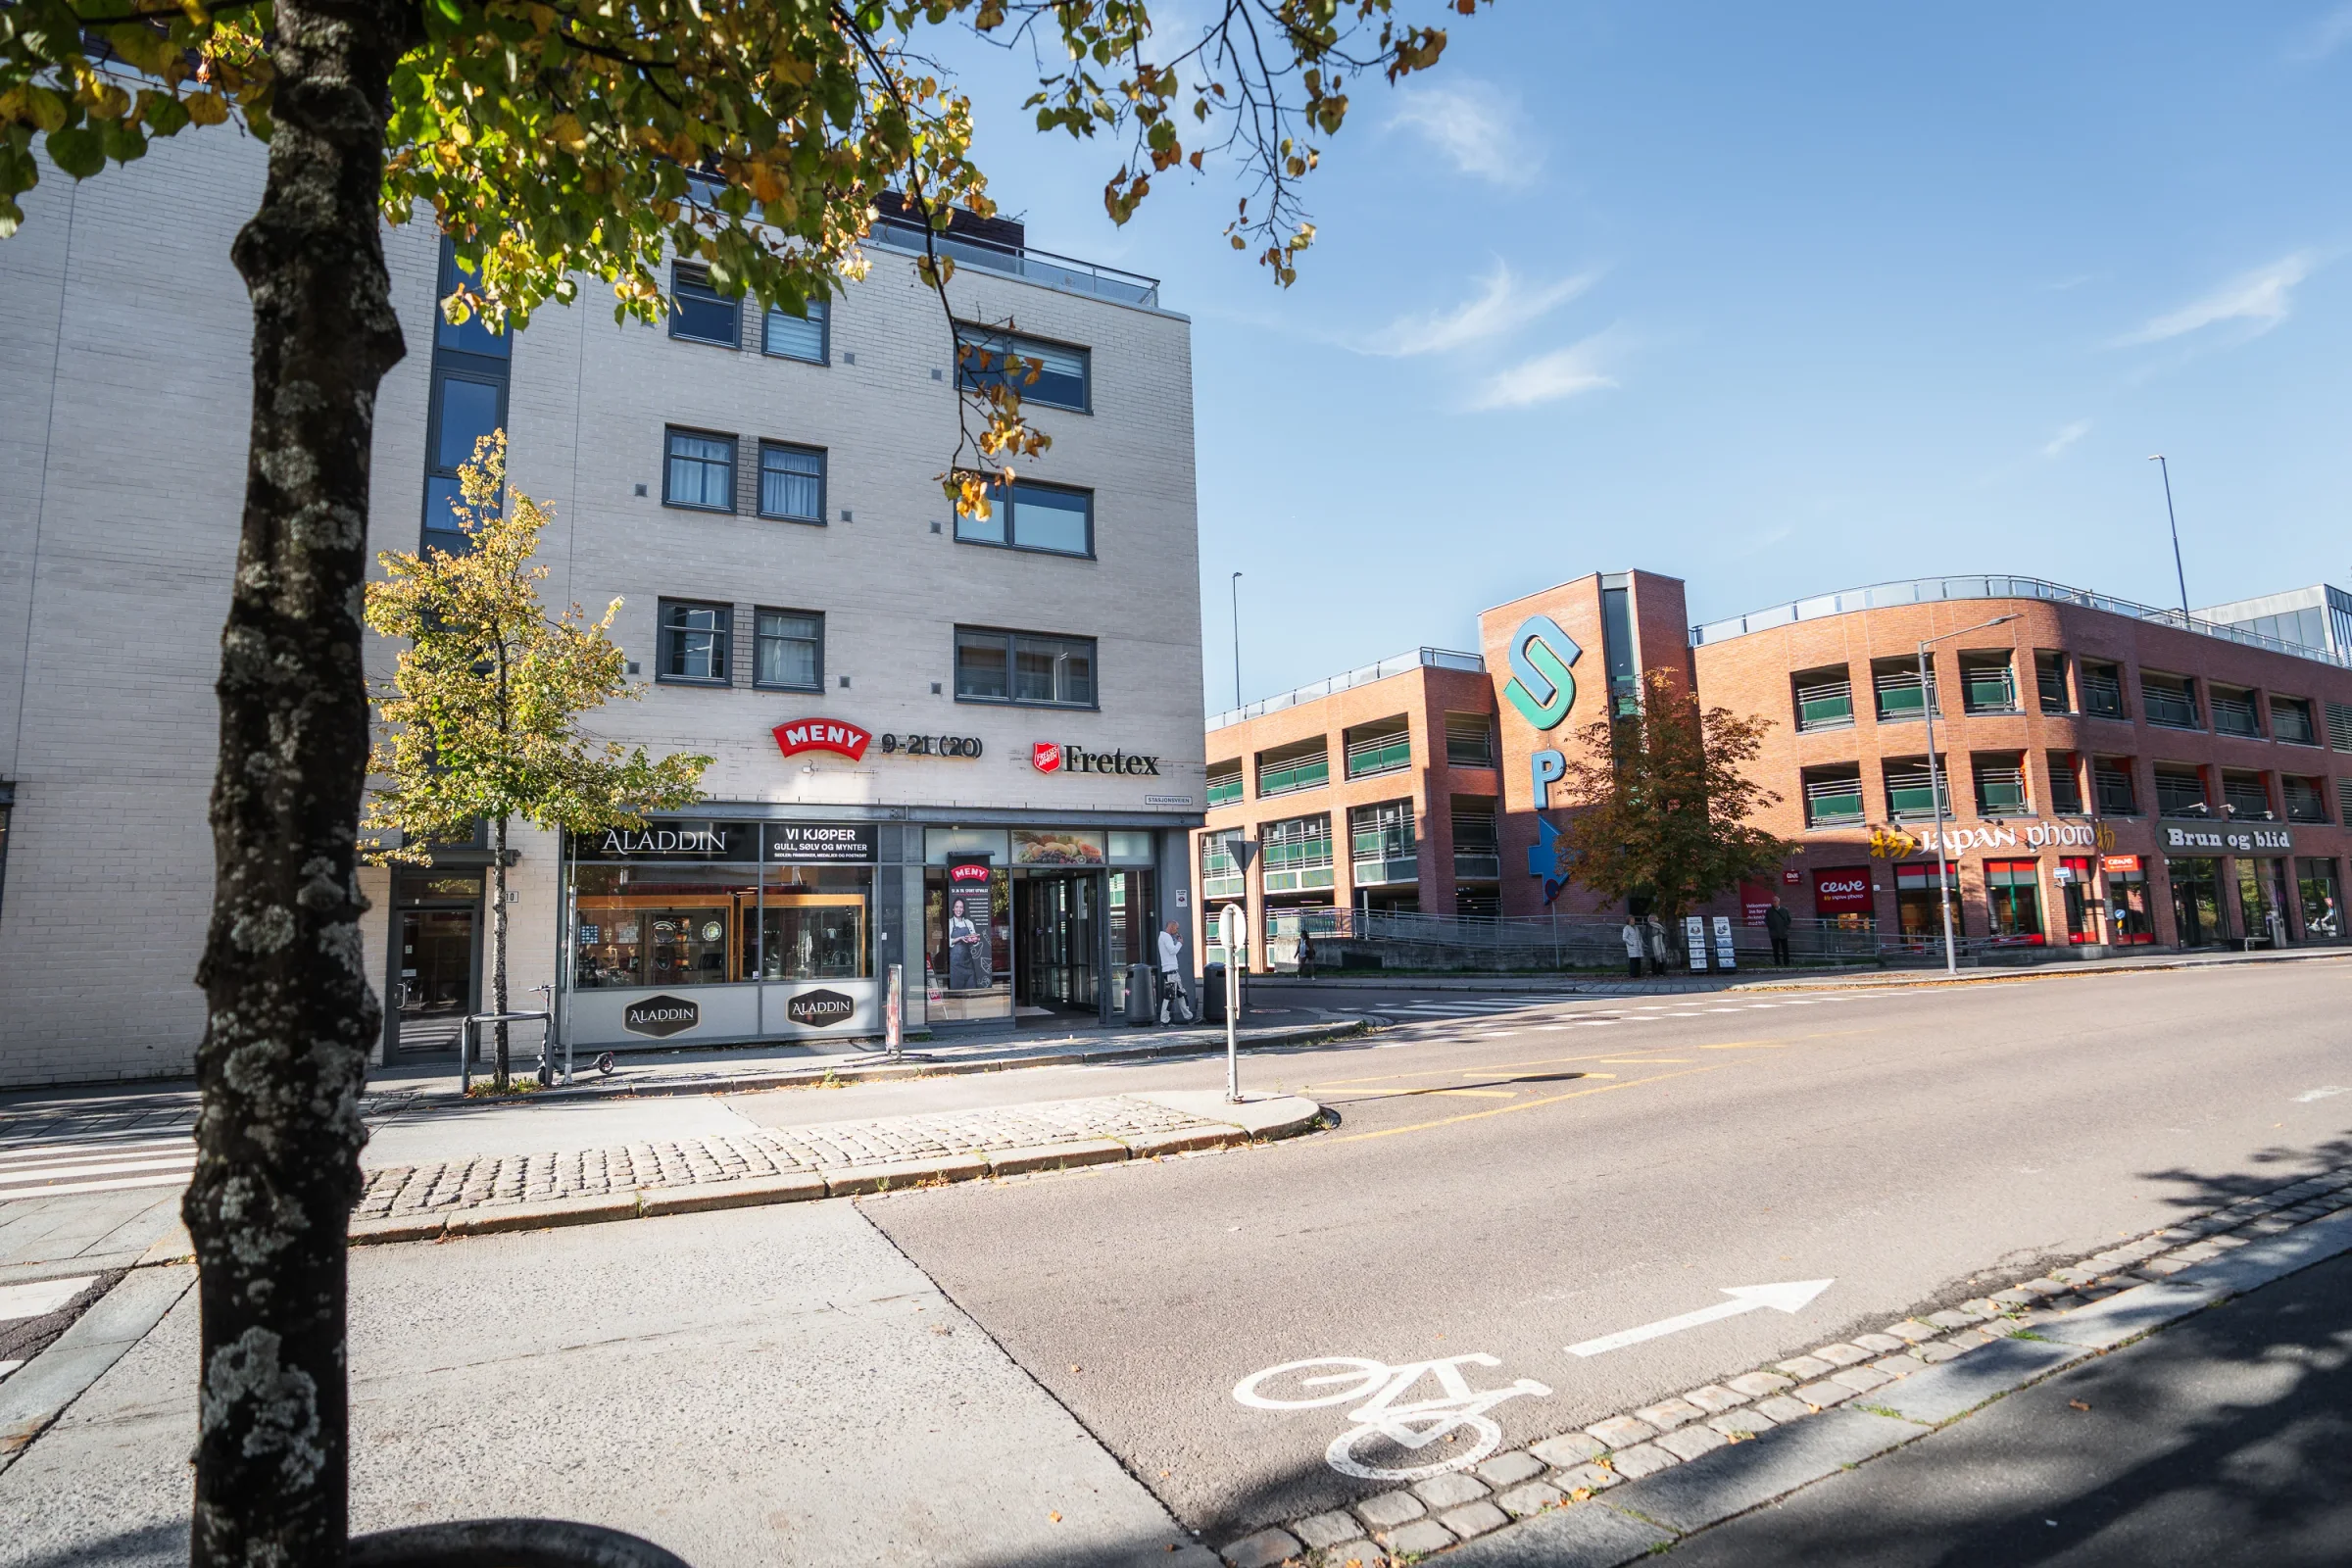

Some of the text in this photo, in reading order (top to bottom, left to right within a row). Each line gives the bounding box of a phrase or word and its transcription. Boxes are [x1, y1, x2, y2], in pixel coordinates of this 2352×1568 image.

[785, 724, 863, 748] MENY
[881, 733, 983, 758] 9-21 (20)
[1063, 745, 1160, 775] Fretex
[1531, 750, 1566, 810] P
[602, 828, 727, 855] ALADDIN
[785, 828, 856, 841] VI KJØPER
[2167, 828, 2290, 850] Brun og blid
[955, 867, 986, 878] MENY
[1820, 880, 1866, 893] cewe
[629, 1008, 694, 1023] ALADDIN
[792, 1001, 850, 1015] ALADDIN
